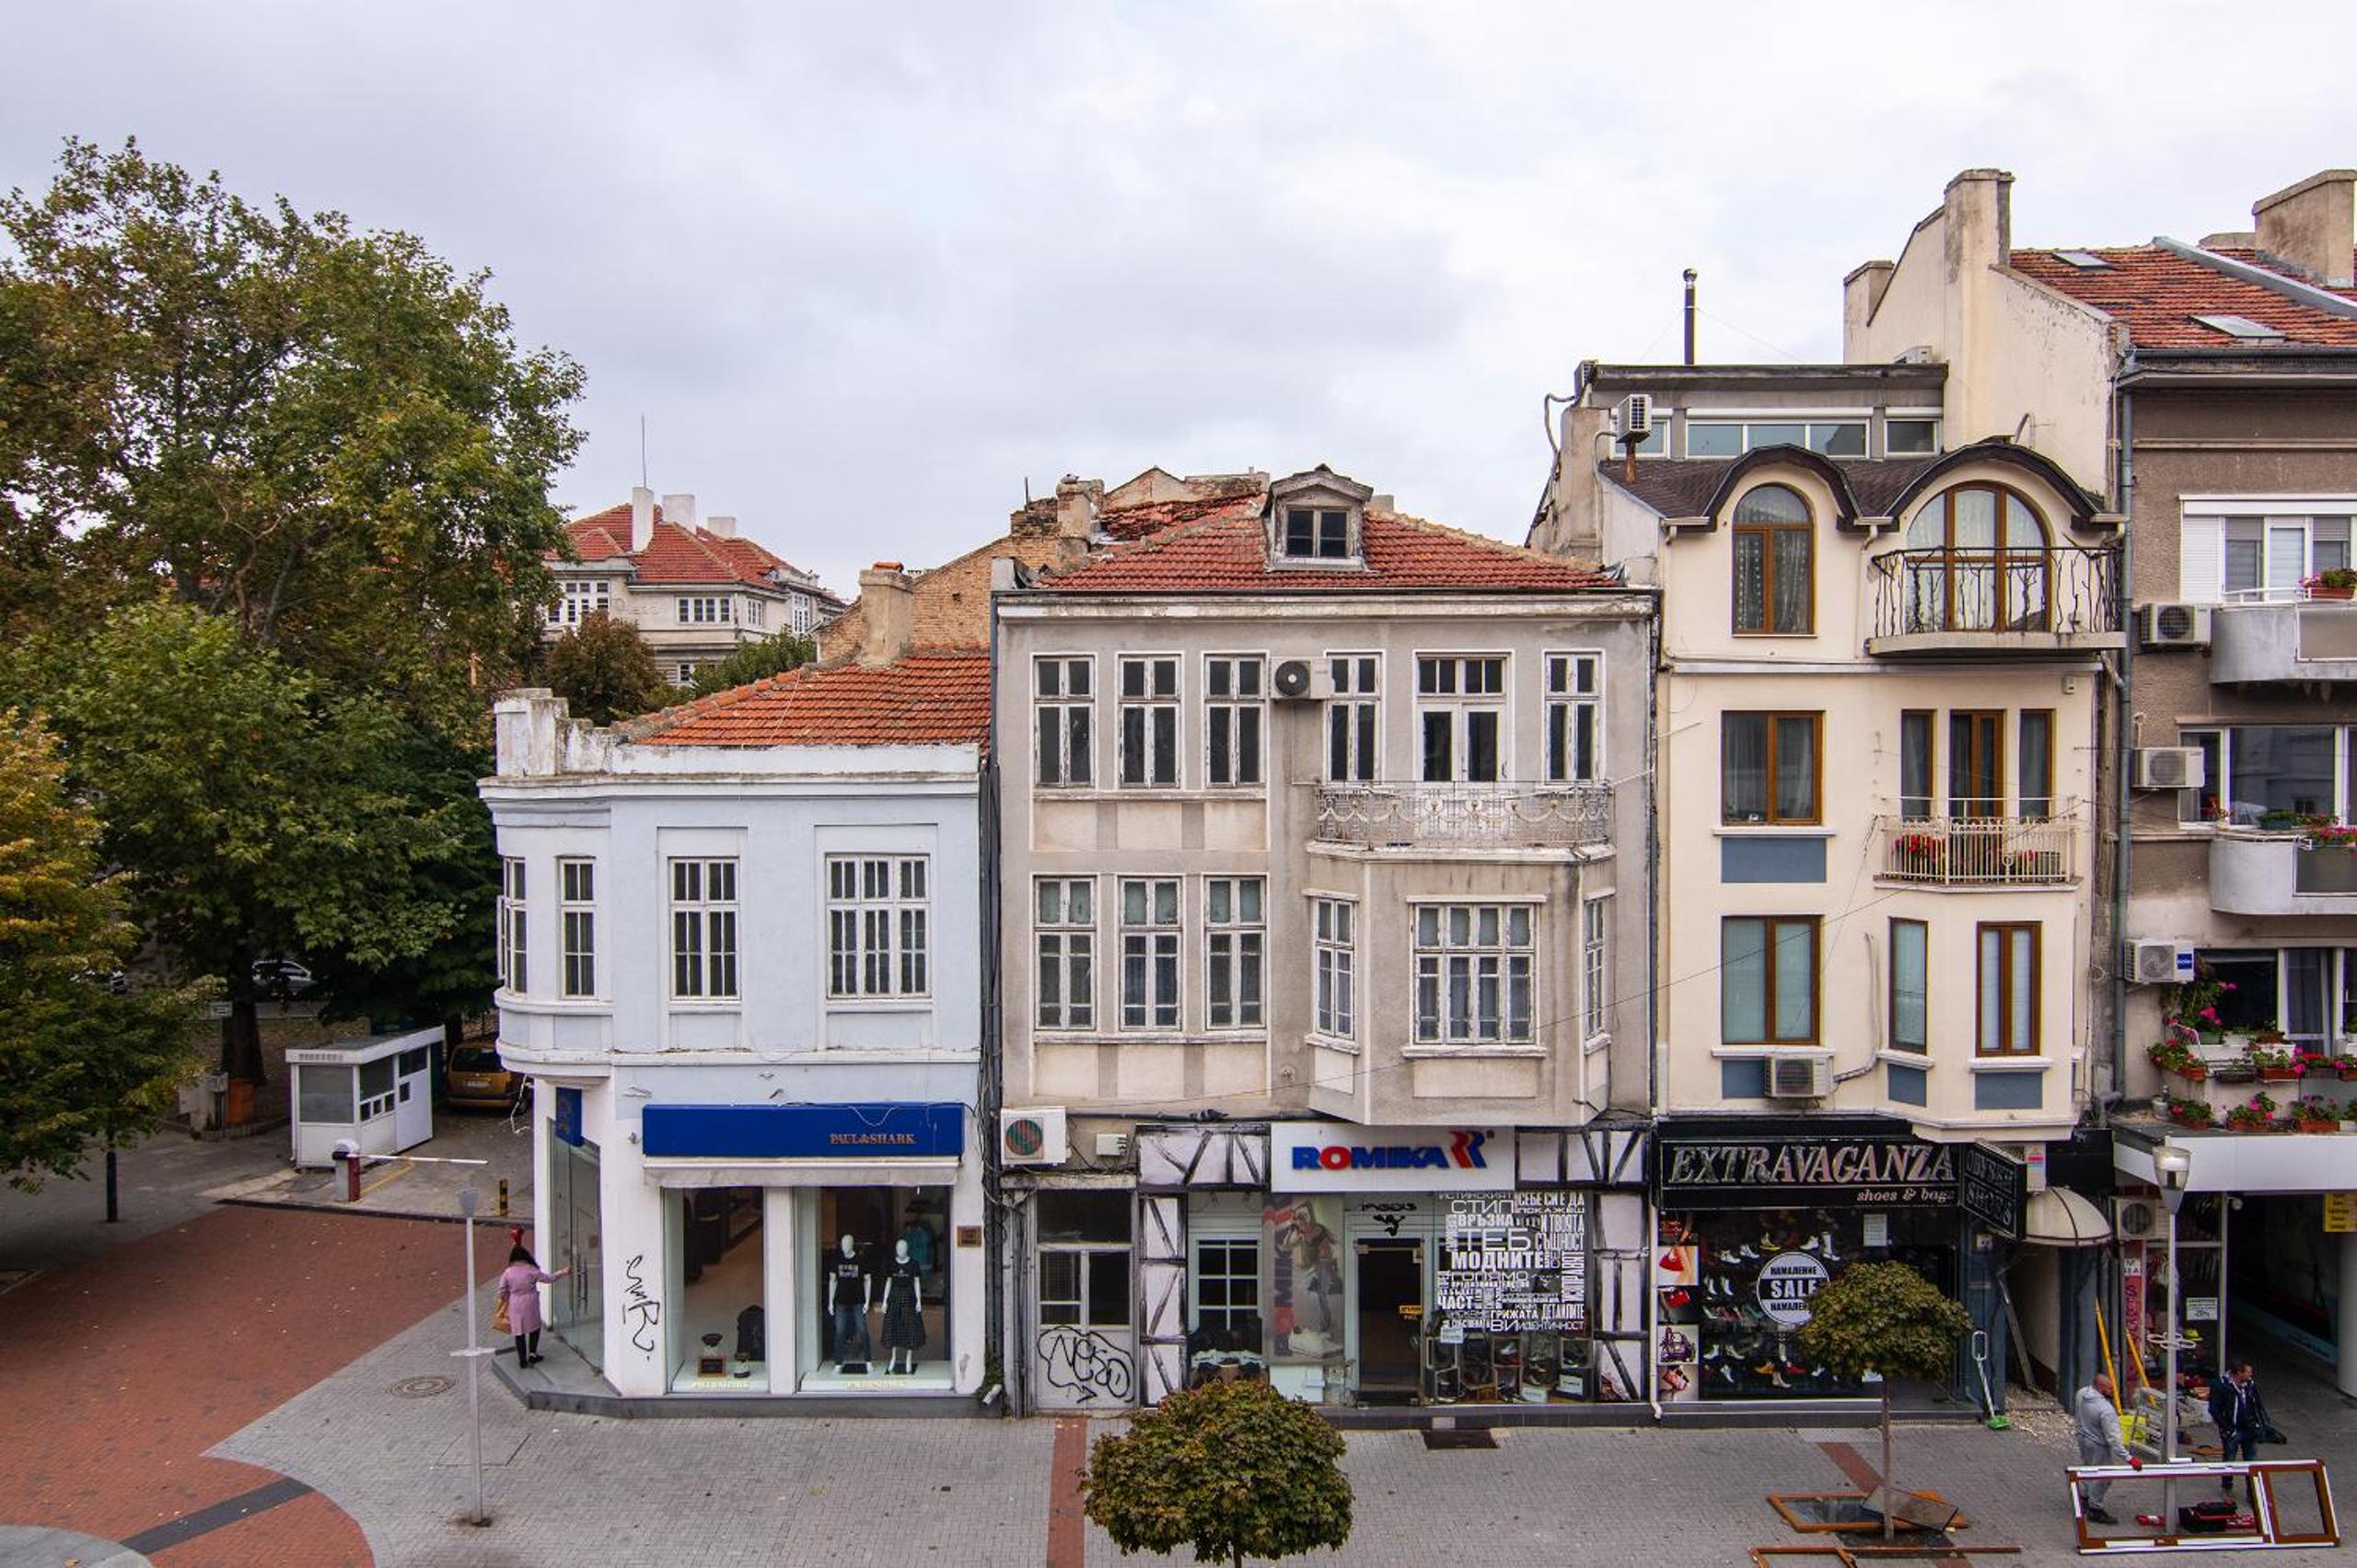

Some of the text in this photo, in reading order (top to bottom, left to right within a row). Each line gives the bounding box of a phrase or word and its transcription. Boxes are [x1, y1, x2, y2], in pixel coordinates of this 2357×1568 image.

[1292, 1146, 1449, 1170] ROMIKA
[1668, 1145, 1956, 1184] EXTRAVAGANZA
[1518, 1192, 1543, 1206] СЕБЕ
[1568, 1192, 1585, 1208] ДА
[1857, 1188, 1898, 1201] shoes
[1903, 1188, 1915, 1201] &
[1550, 1214, 1585, 1233] ТВОЯТА
[1457, 1227, 1531, 1251] ТЕБ
[1535, 1233, 1585, 1251] СЪЩНОСТ
[1451, 1251, 1544, 1272] МОДНИТЕ
[1771, 1266, 1817, 1275] НАМАЛЕНИЕ
[1771, 1280, 1817, 1298] SALE
[1437, 1295, 1473, 1309] ЧАСТ
[1771, 1301, 1810, 1311] НАМАЛЕ
[1491, 1309, 1539, 1319] ГРИЖАТА
[1491, 1319, 1519, 1331] ВИ
